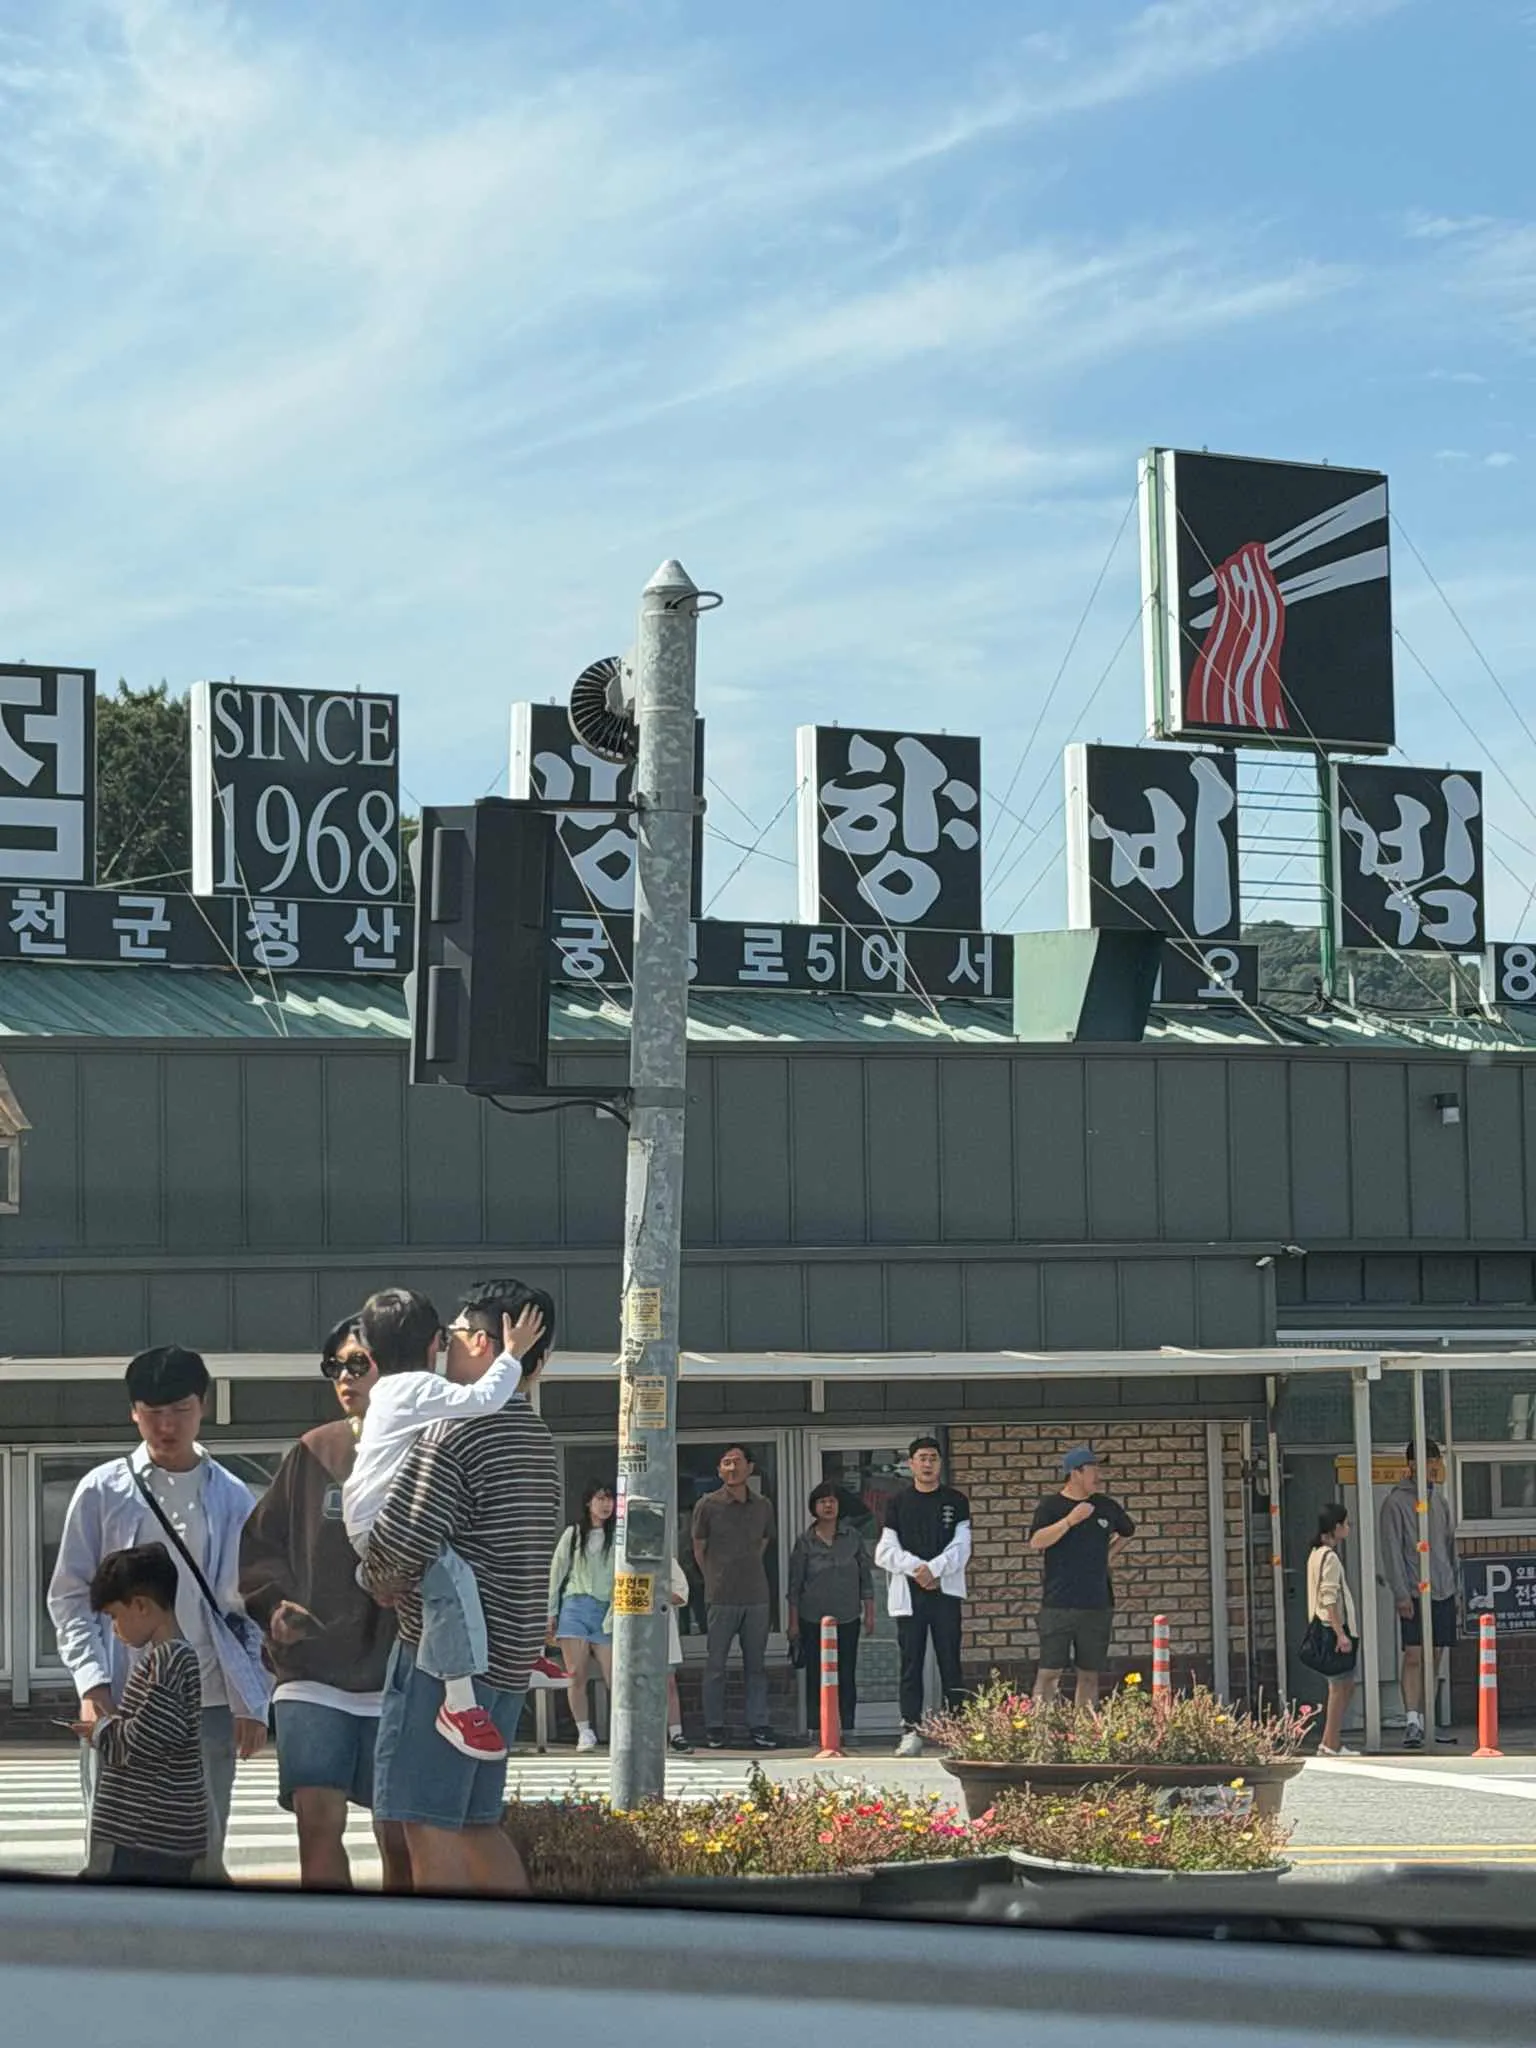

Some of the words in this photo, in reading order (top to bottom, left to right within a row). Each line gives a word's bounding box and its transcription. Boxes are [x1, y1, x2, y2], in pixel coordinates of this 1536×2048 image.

[214, 688, 396, 766] SINCE
[214, 783, 396, 896] 1968
[861, 931, 993, 996] 어서
[1485, 1565, 1512, 1608] P
